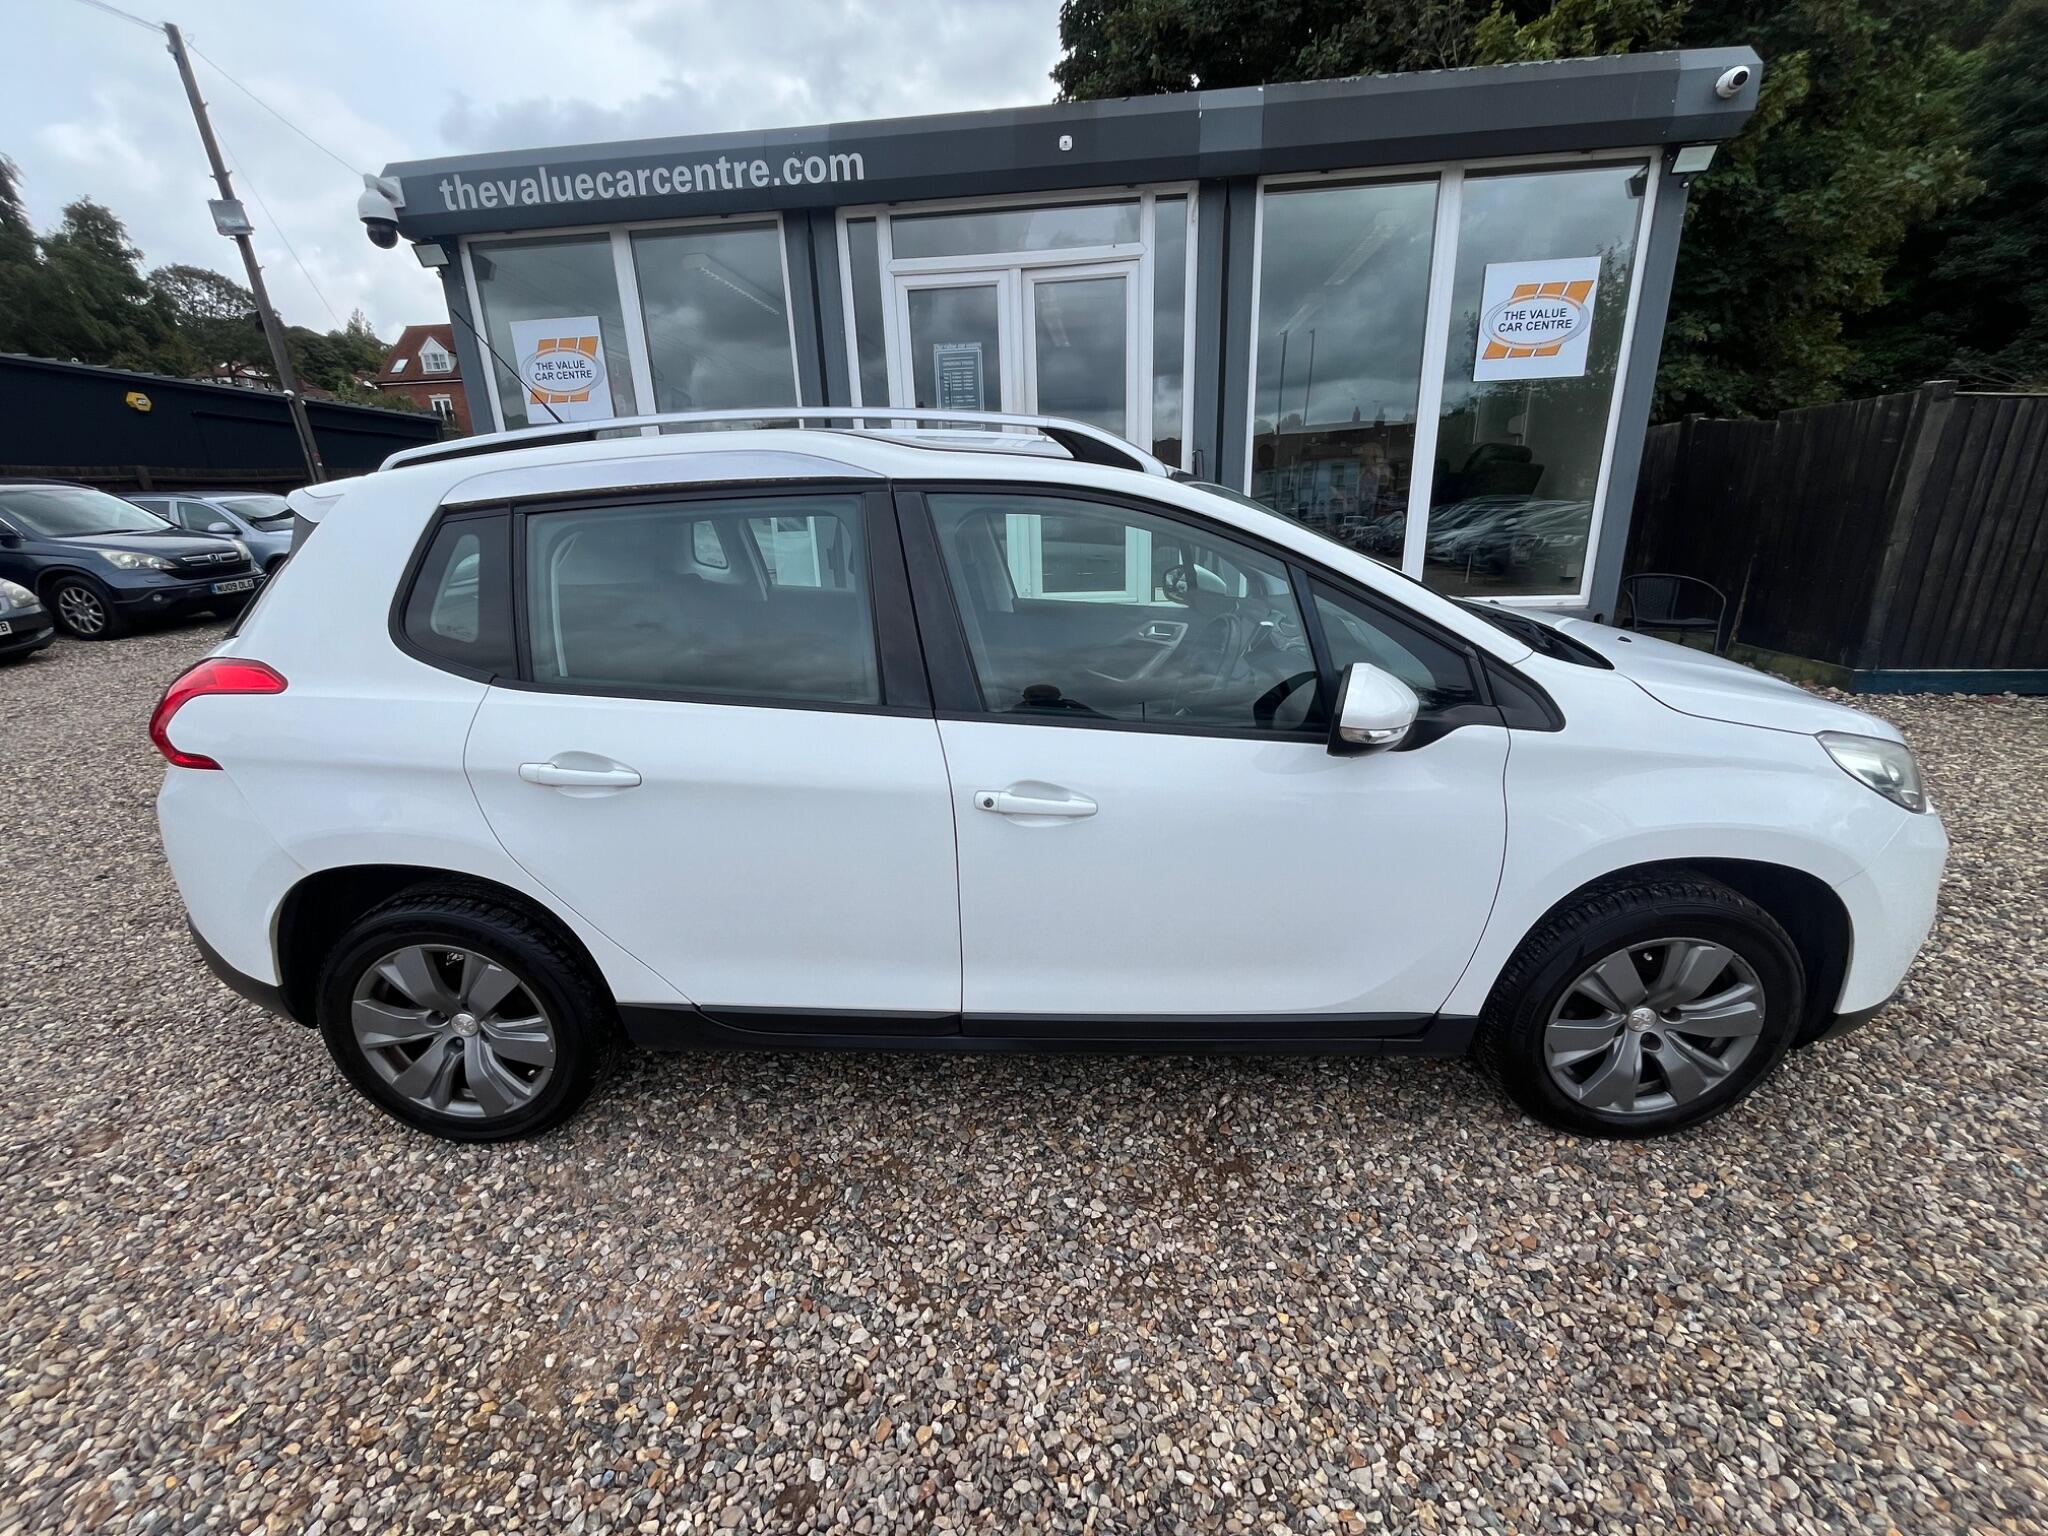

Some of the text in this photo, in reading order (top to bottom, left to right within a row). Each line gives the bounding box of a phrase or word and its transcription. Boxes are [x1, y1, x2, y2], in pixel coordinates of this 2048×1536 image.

[438, 152, 865, 212] thevaluecarcentre.com
[1504, 308, 1567, 320] THE VALUE
[1498, 319, 1572, 332] CAR CENTRE
[536, 360, 585, 371] THE VALUE
[534, 370, 593, 381] CAR CENTRE
